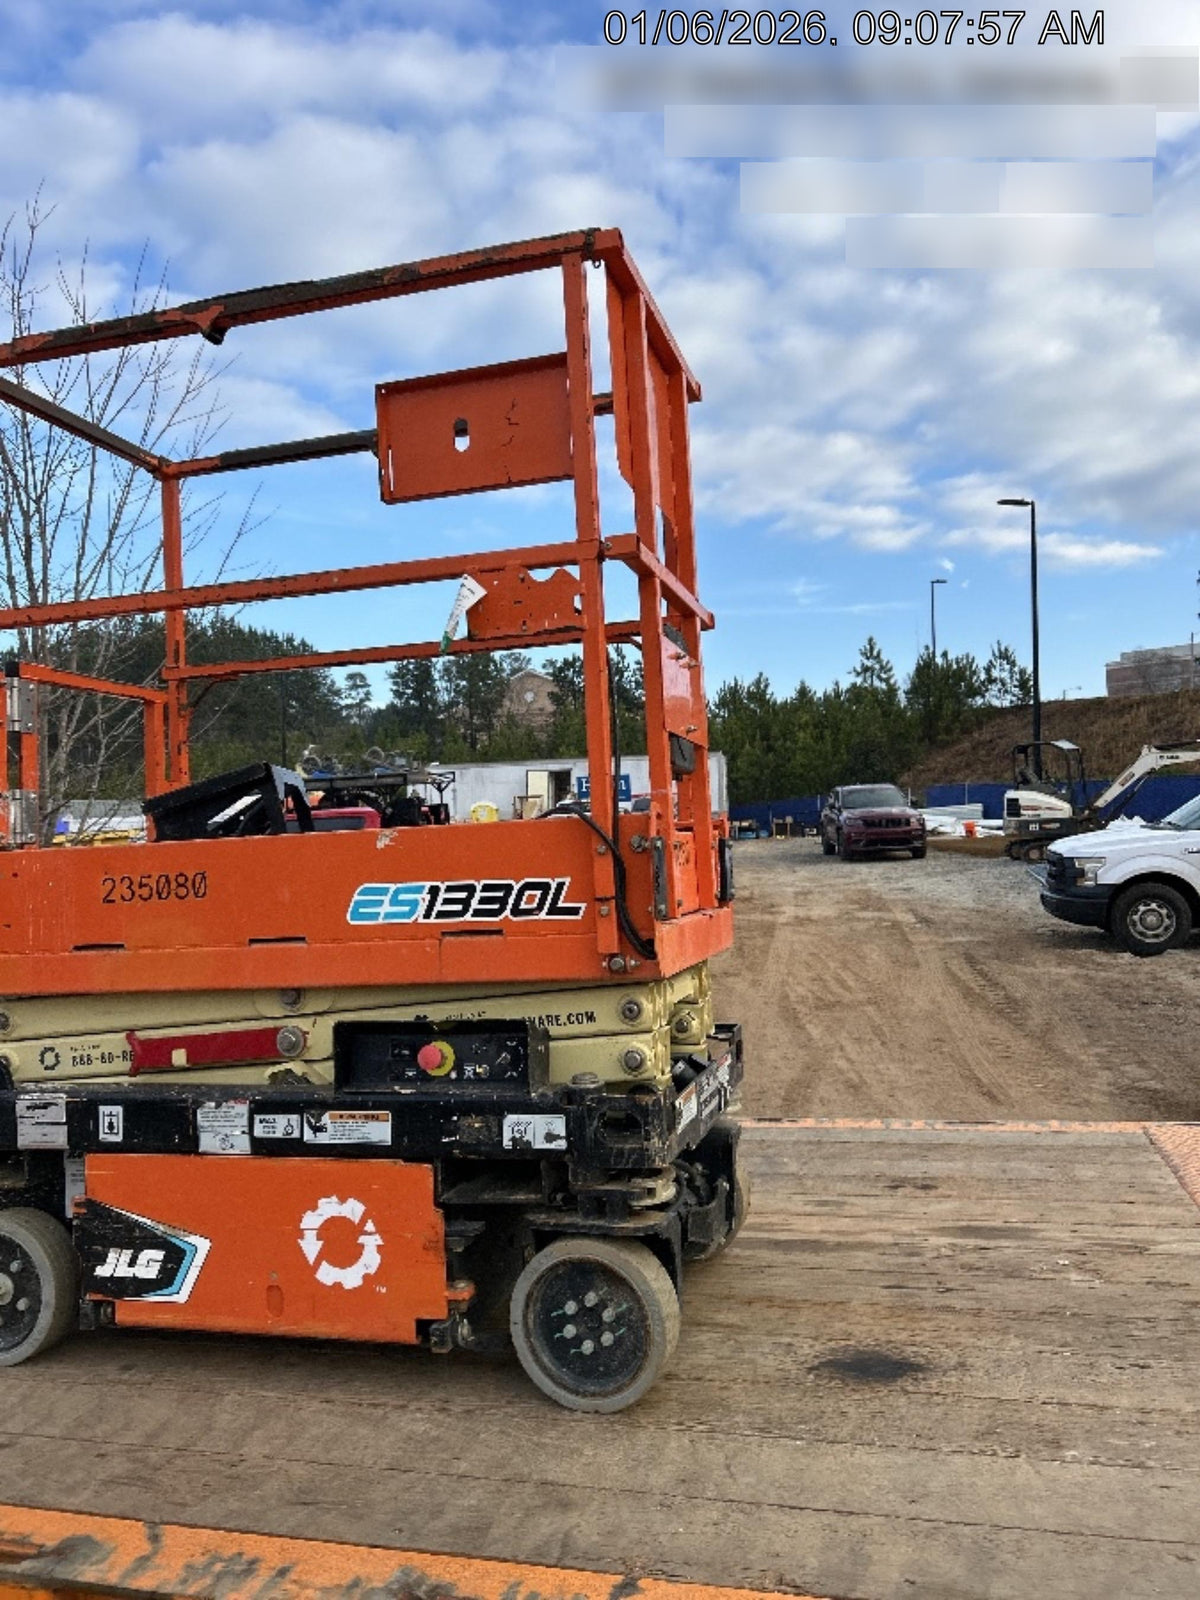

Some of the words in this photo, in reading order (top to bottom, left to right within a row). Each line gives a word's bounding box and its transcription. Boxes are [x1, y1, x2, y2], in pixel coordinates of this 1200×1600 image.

[102, 871, 206, 903] 235080
[347, 877, 586, 924] ES1330L
[93, 1248, 166, 1280] JLG
